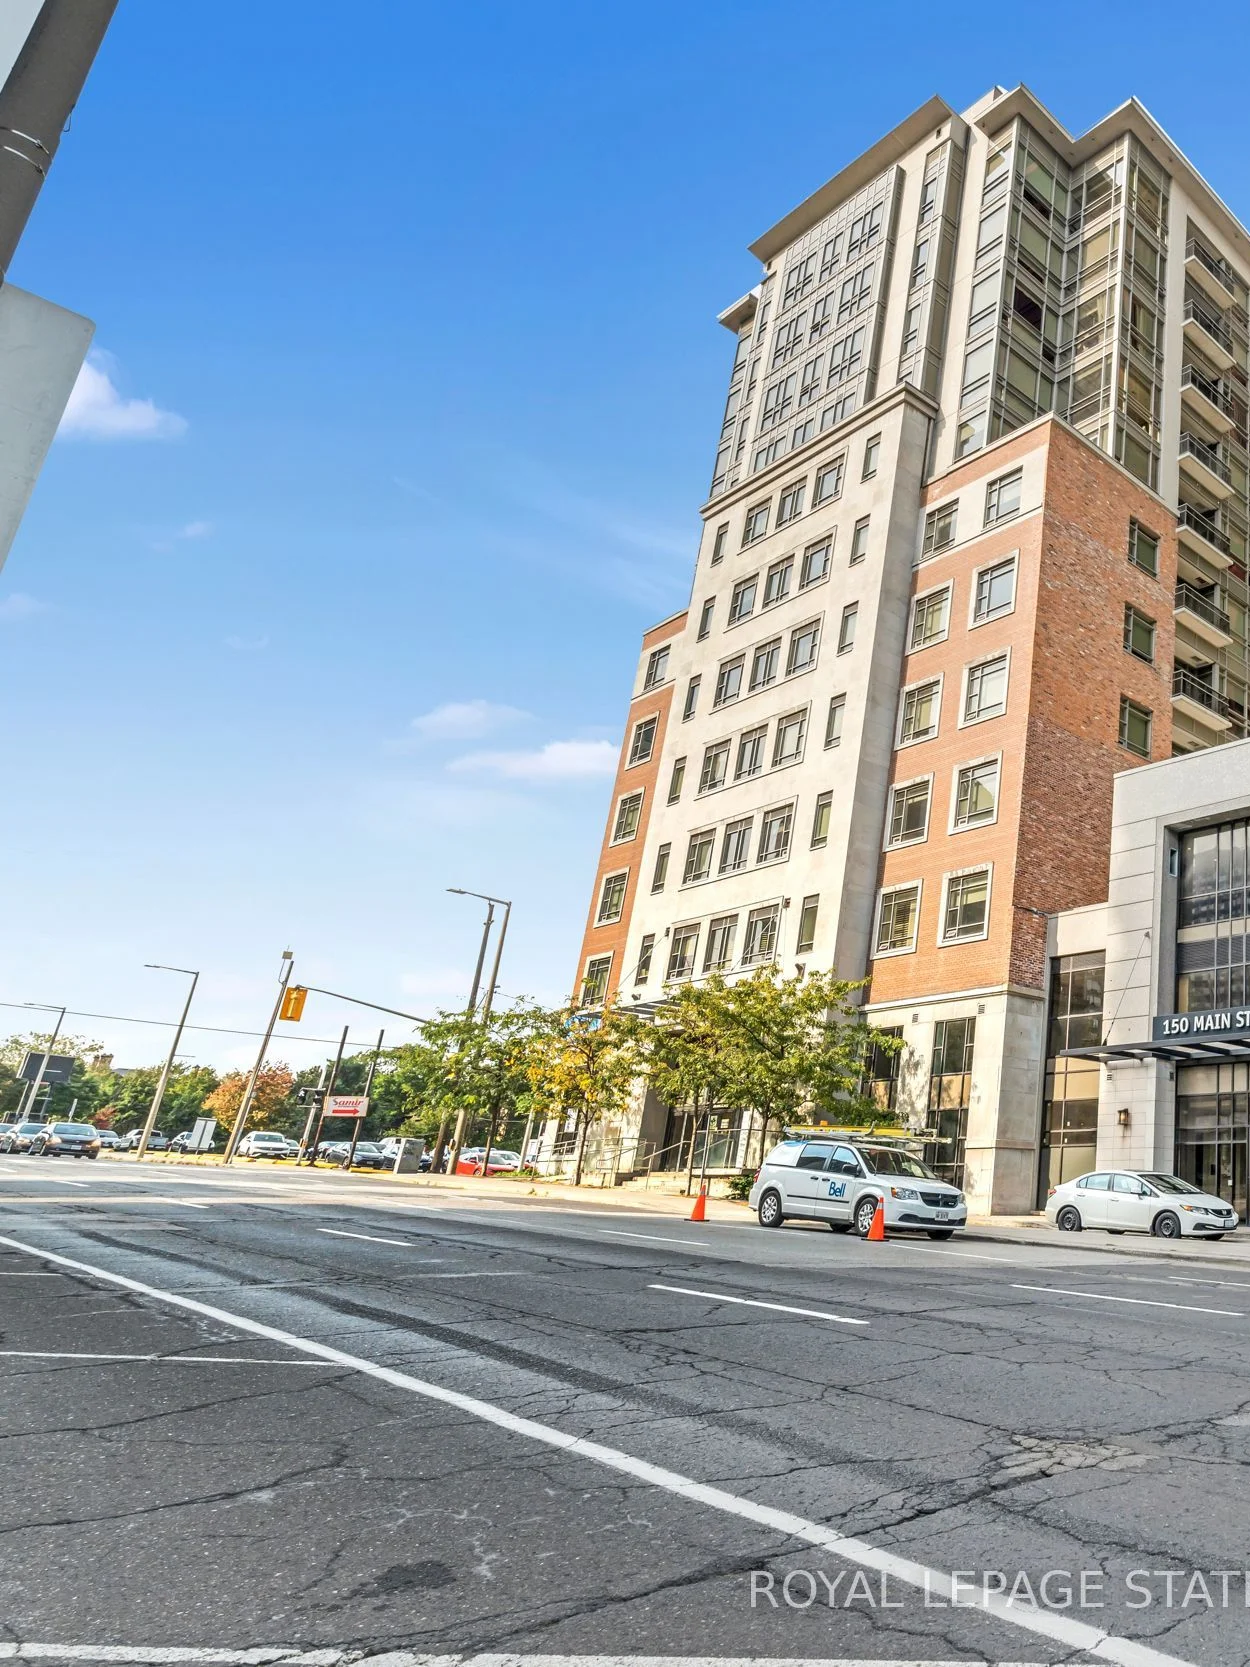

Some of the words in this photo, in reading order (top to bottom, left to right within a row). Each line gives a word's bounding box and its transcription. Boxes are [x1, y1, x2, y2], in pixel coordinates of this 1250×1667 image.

[1163, 1017, 1189, 1035] 150
[1193, 1012, 1231, 1032] MAIN
[333, 1098, 364, 1106] Samir
[829, 1181, 846, 1198] Bell
